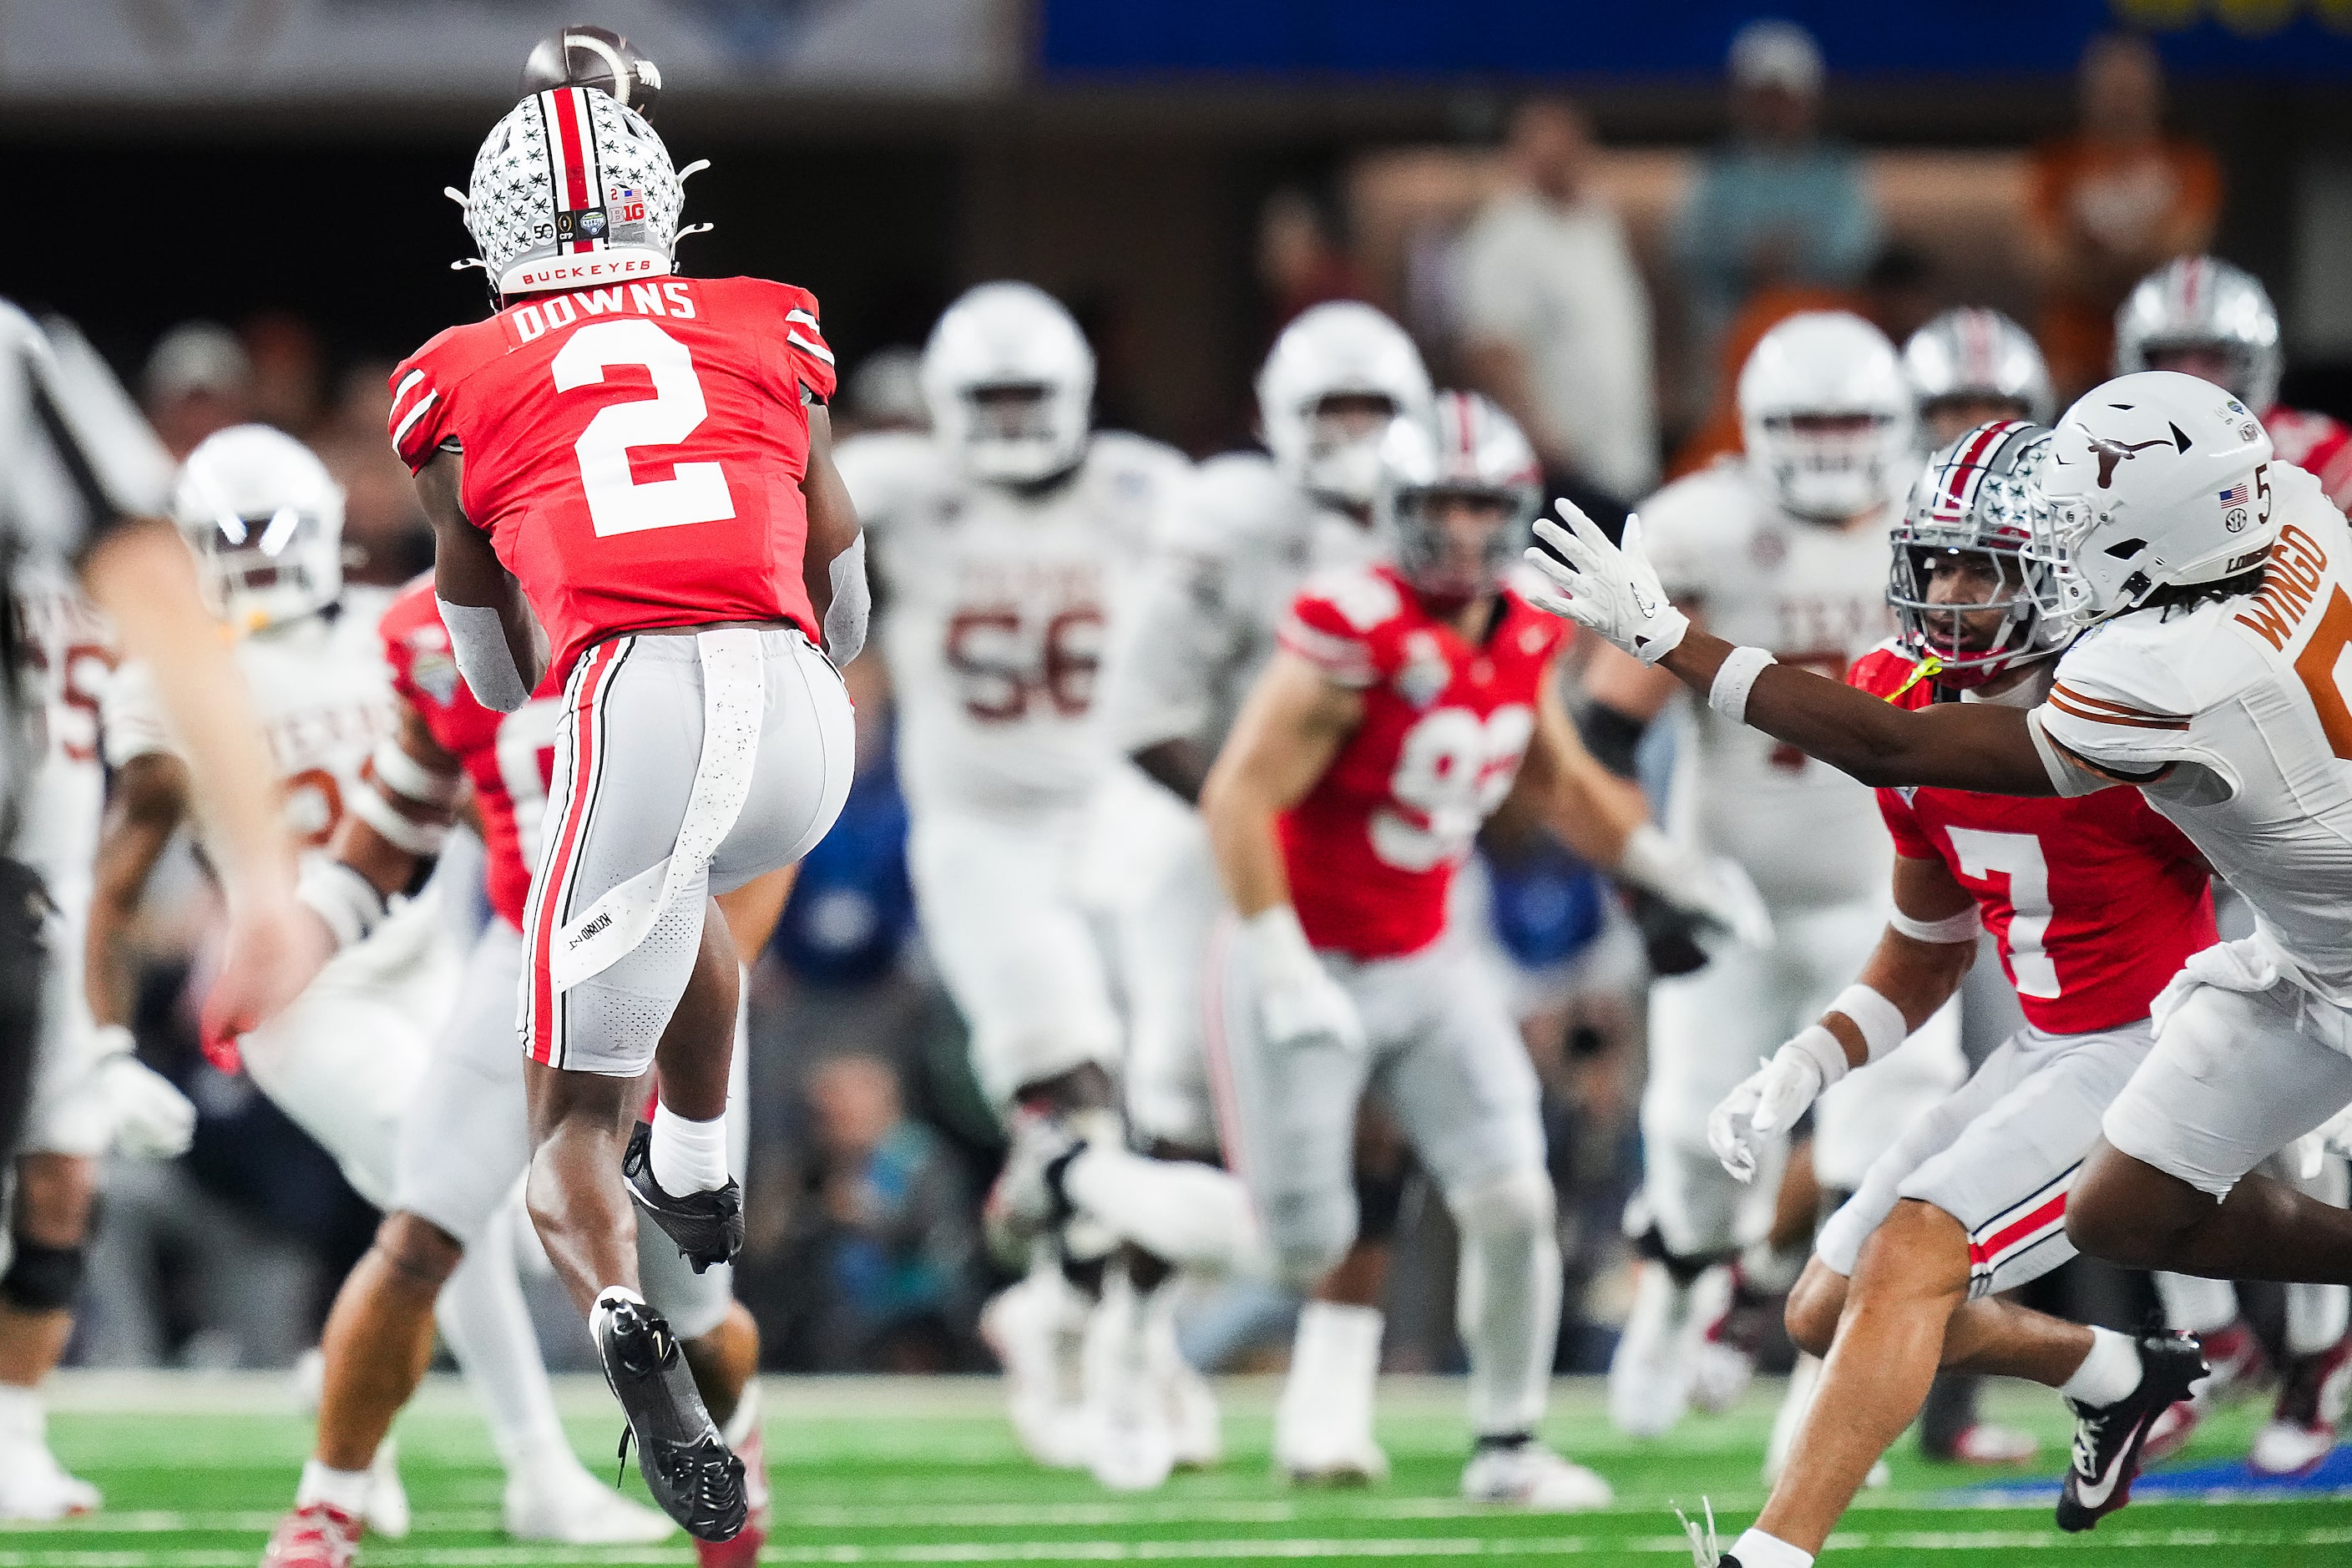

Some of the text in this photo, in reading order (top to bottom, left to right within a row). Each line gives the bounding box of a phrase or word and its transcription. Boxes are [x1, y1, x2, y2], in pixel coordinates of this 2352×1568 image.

[610, 188, 618, 200] 2
[522, 260, 650, 285] BUCKEYES
[512, 282, 696, 343] DOWNS
[551, 318, 736, 539] 2
[2255, 463, 2271, 524] 5
[2233, 524, 2328, 652] WINGO
[581, 913, 613, 940] NXTRND
[1945, 823, 2062, 999] 7
